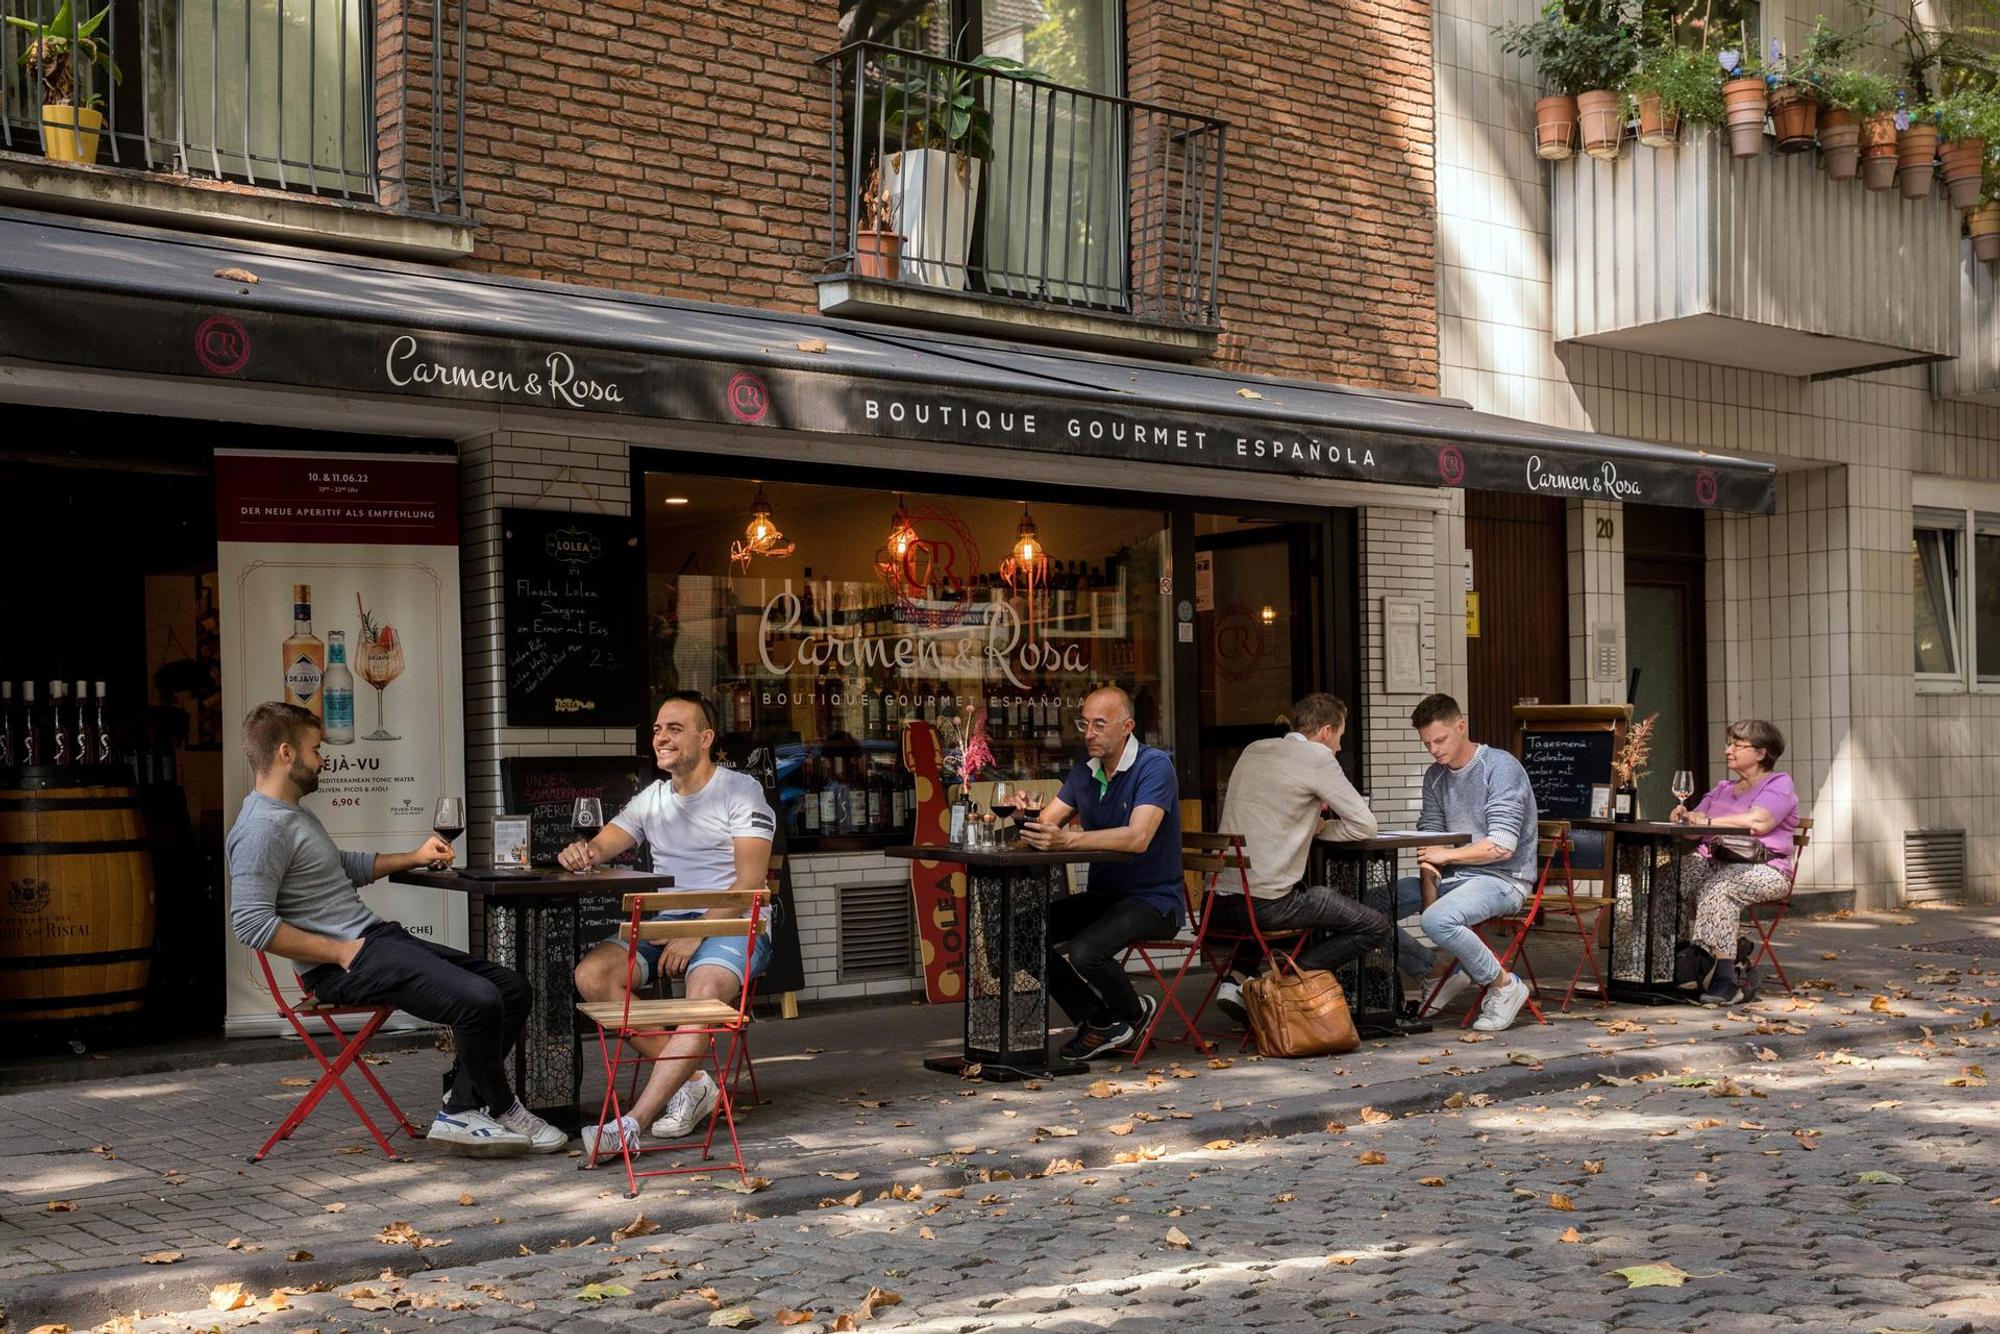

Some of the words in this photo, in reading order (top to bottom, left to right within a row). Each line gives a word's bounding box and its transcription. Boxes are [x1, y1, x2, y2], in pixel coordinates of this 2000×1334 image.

[385, 334, 520, 393] Carmen
[523, 372, 542, 396] &
[545, 350, 625, 408] Rosa
[865, 400, 1037, 434] BOUTIQUE
[1067, 418, 1207, 451] GOURMET
[1236, 438, 1376, 467] ESPAÑOLA
[308, 472, 322, 483] 10.
[322, 473, 331, 483] &
[332, 473, 369, 484] 11.06.22
[1526, 455, 1590, 492] Carmen
[1591, 477, 1602, 492] &
[1601, 460, 1642, 500] Rosa
[241, 507, 261, 516] DER
[264, 507, 293, 516] NEUE
[296, 508, 342, 517] APERITIF
[345, 509, 364, 517] ALS
[367, 509, 435, 519] EMPFEHLUNG
[1596, 517, 1614, 539] 20
[557, 541, 590, 552] LOLEA
[565, 580, 599, 598] Lolea
[541, 600, 587, 620] Sangria
[533, 618, 564, 634] Eimer
[589, 620, 608, 636] Eis
[568, 643, 583, 652] nur
[758, 592, 942, 676] Carmen
[955, 635, 980, 669] &
[982, 598, 1091, 691] Rosa
[762, 692, 870, 707] BOUTIQUE
[884, 694, 976, 707] GOURMET
[989, 693, 1086, 708] ESPAÑOLA
[322, 754, 380, 773] ÉJÀ-VU
[332, 798, 353, 807] 6,90
[355, 798, 361, 806] €
[935, 872, 965, 970] LOLEA
